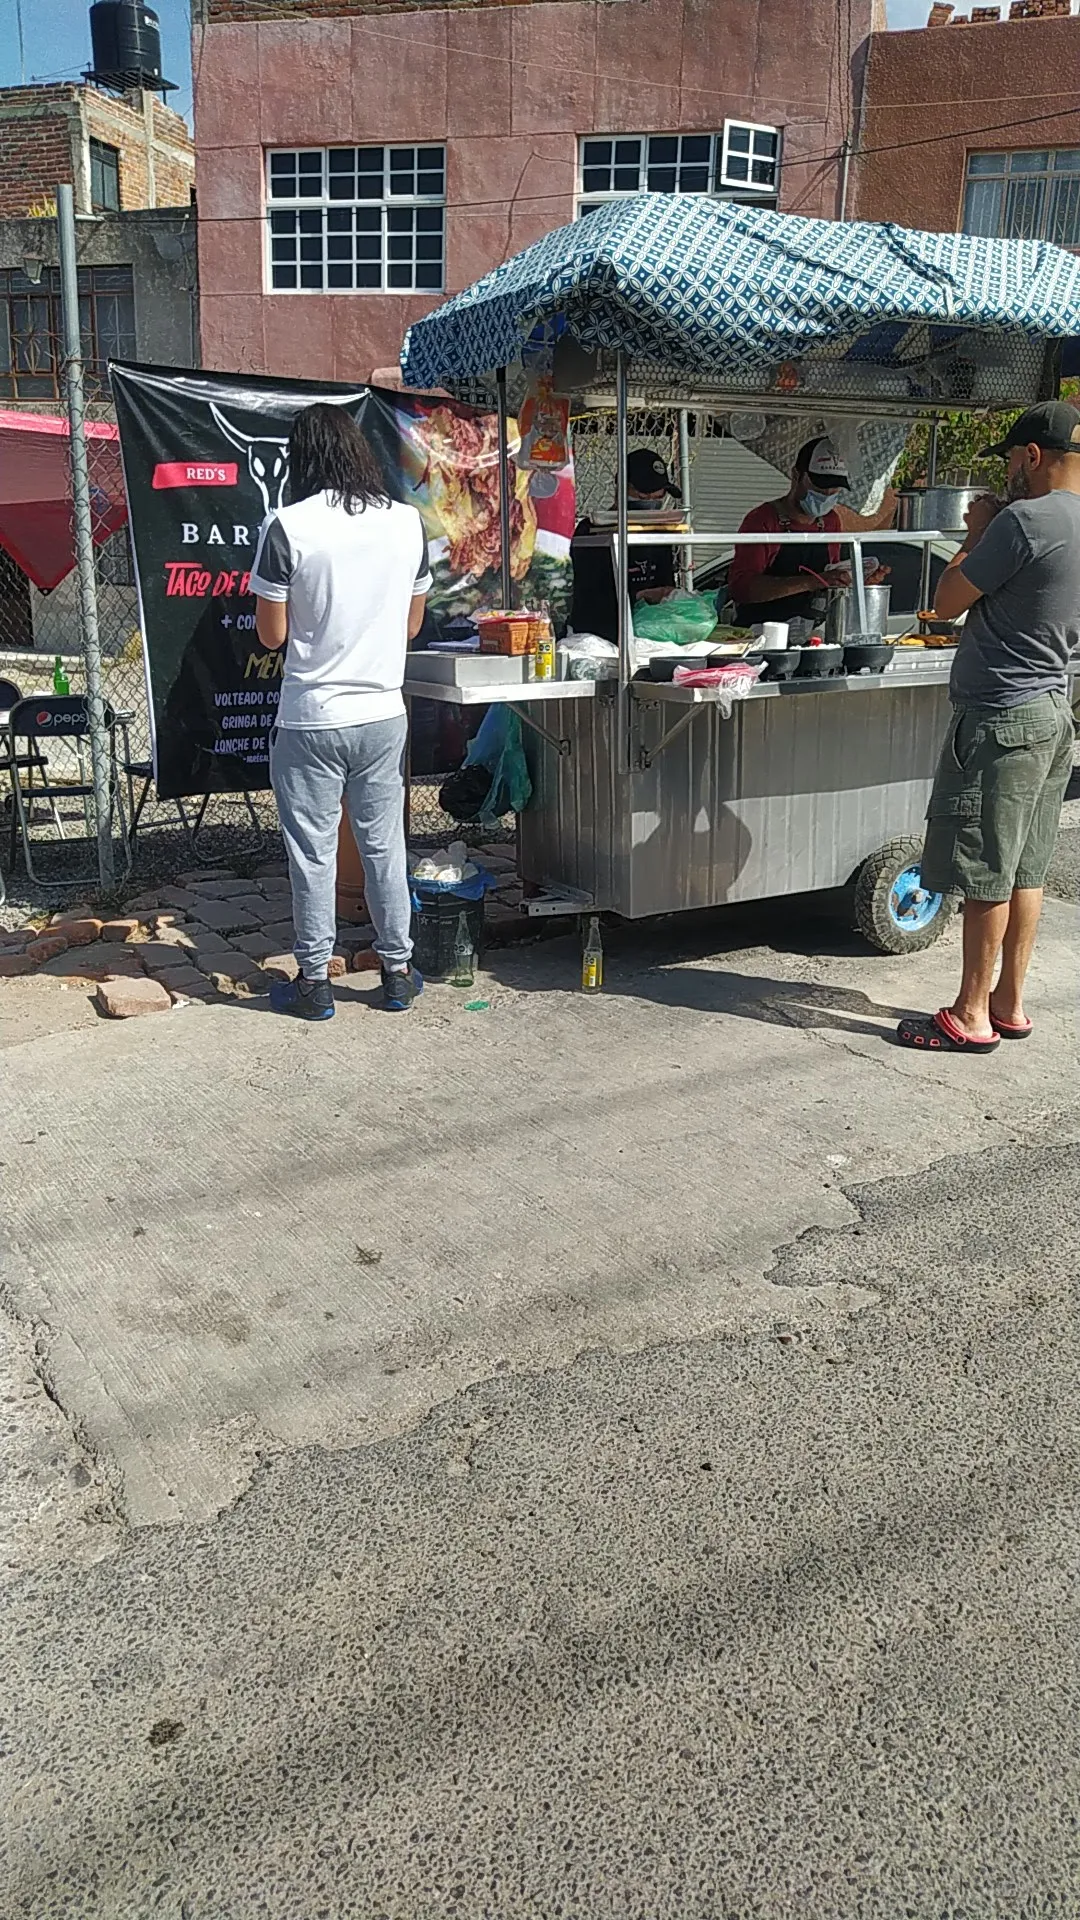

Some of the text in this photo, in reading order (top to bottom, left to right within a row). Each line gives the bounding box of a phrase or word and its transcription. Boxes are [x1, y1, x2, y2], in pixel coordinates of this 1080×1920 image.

[182, 523, 262, 545] BAR
[165, 562, 255, 597] TACO DE B
[214, 691, 264, 707] VOLTEADO
[53, 713, 86, 727] peps
[221, 713, 273, 730] GRINGA DE
[214, 736, 266, 753] LONCHE DE
